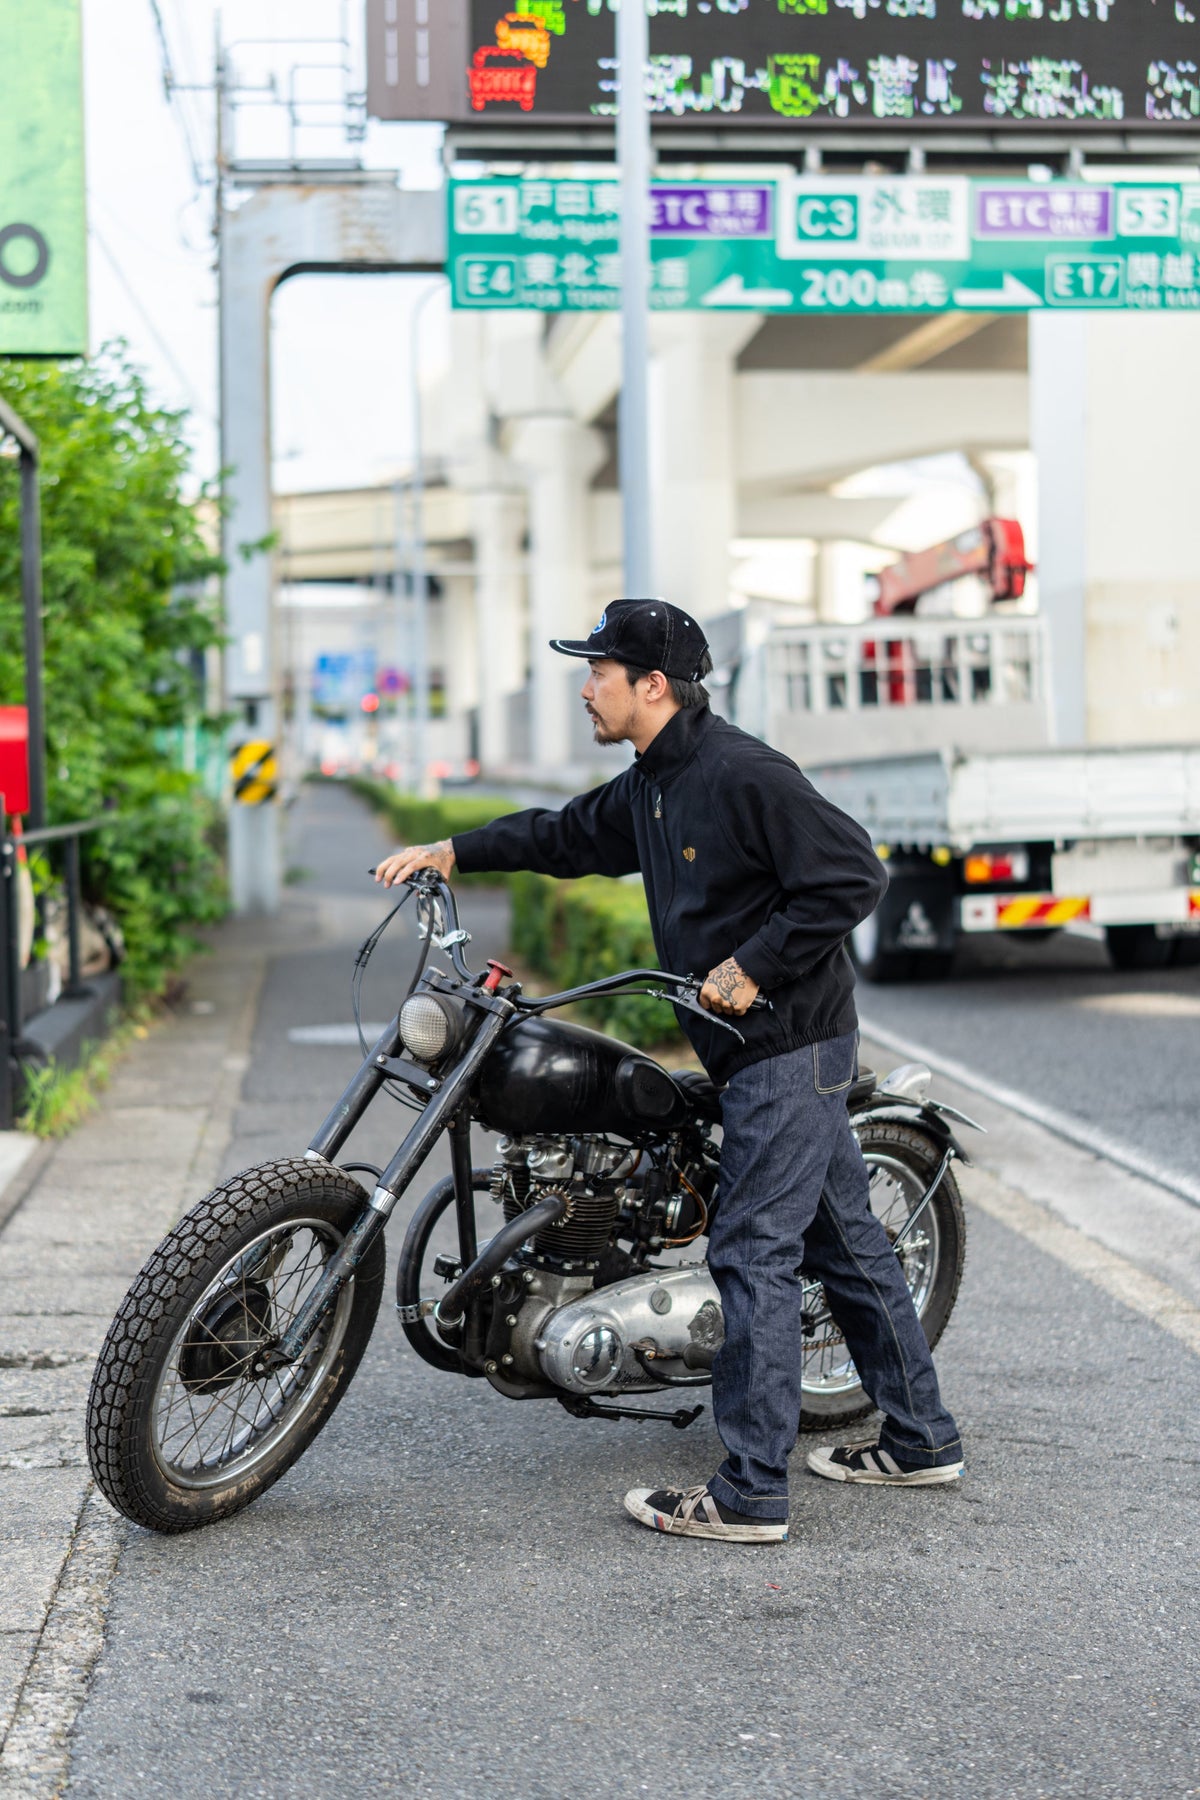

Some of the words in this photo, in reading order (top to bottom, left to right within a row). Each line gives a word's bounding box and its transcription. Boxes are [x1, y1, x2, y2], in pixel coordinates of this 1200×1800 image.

[463, 194, 508, 227] 61
[645, 196, 704, 226] ETC
[799, 198, 856, 237] C3
[984, 195, 1047, 228] ETC
[1125, 196, 1169, 230] 53
[466, 262, 512, 295] E4
[1052, 263, 1119, 298] E17
